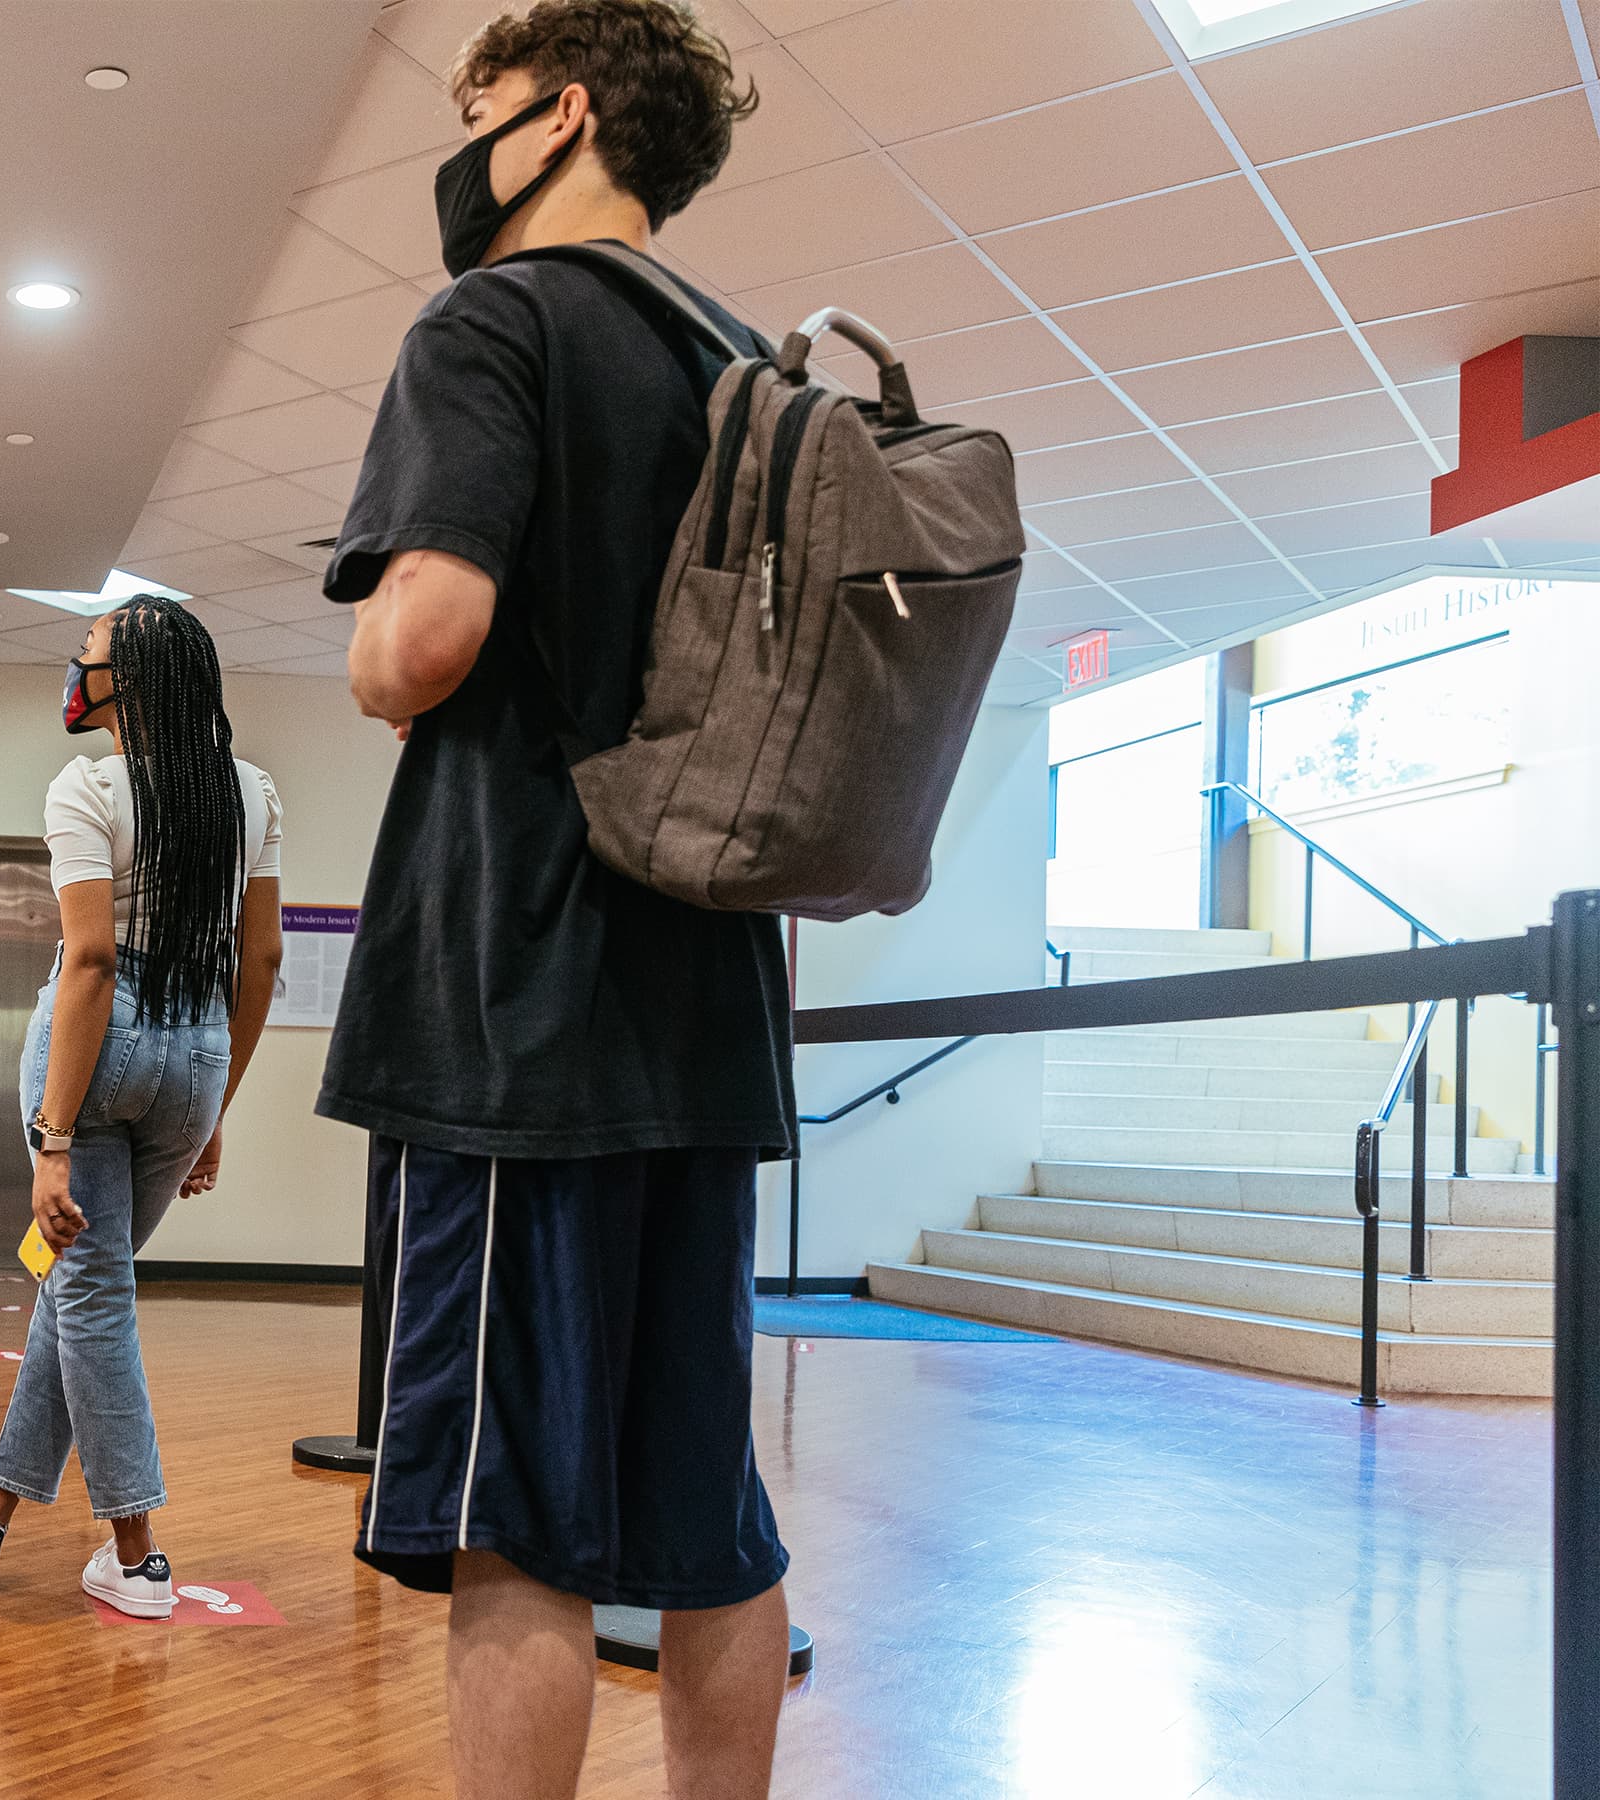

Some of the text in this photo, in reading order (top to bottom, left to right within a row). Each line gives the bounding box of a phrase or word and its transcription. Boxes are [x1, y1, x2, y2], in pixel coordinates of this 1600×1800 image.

[1068, 640, 1101, 685] EXIT
[293, 914, 327, 925] Modern
[327, 915, 351, 926] Jesuit
